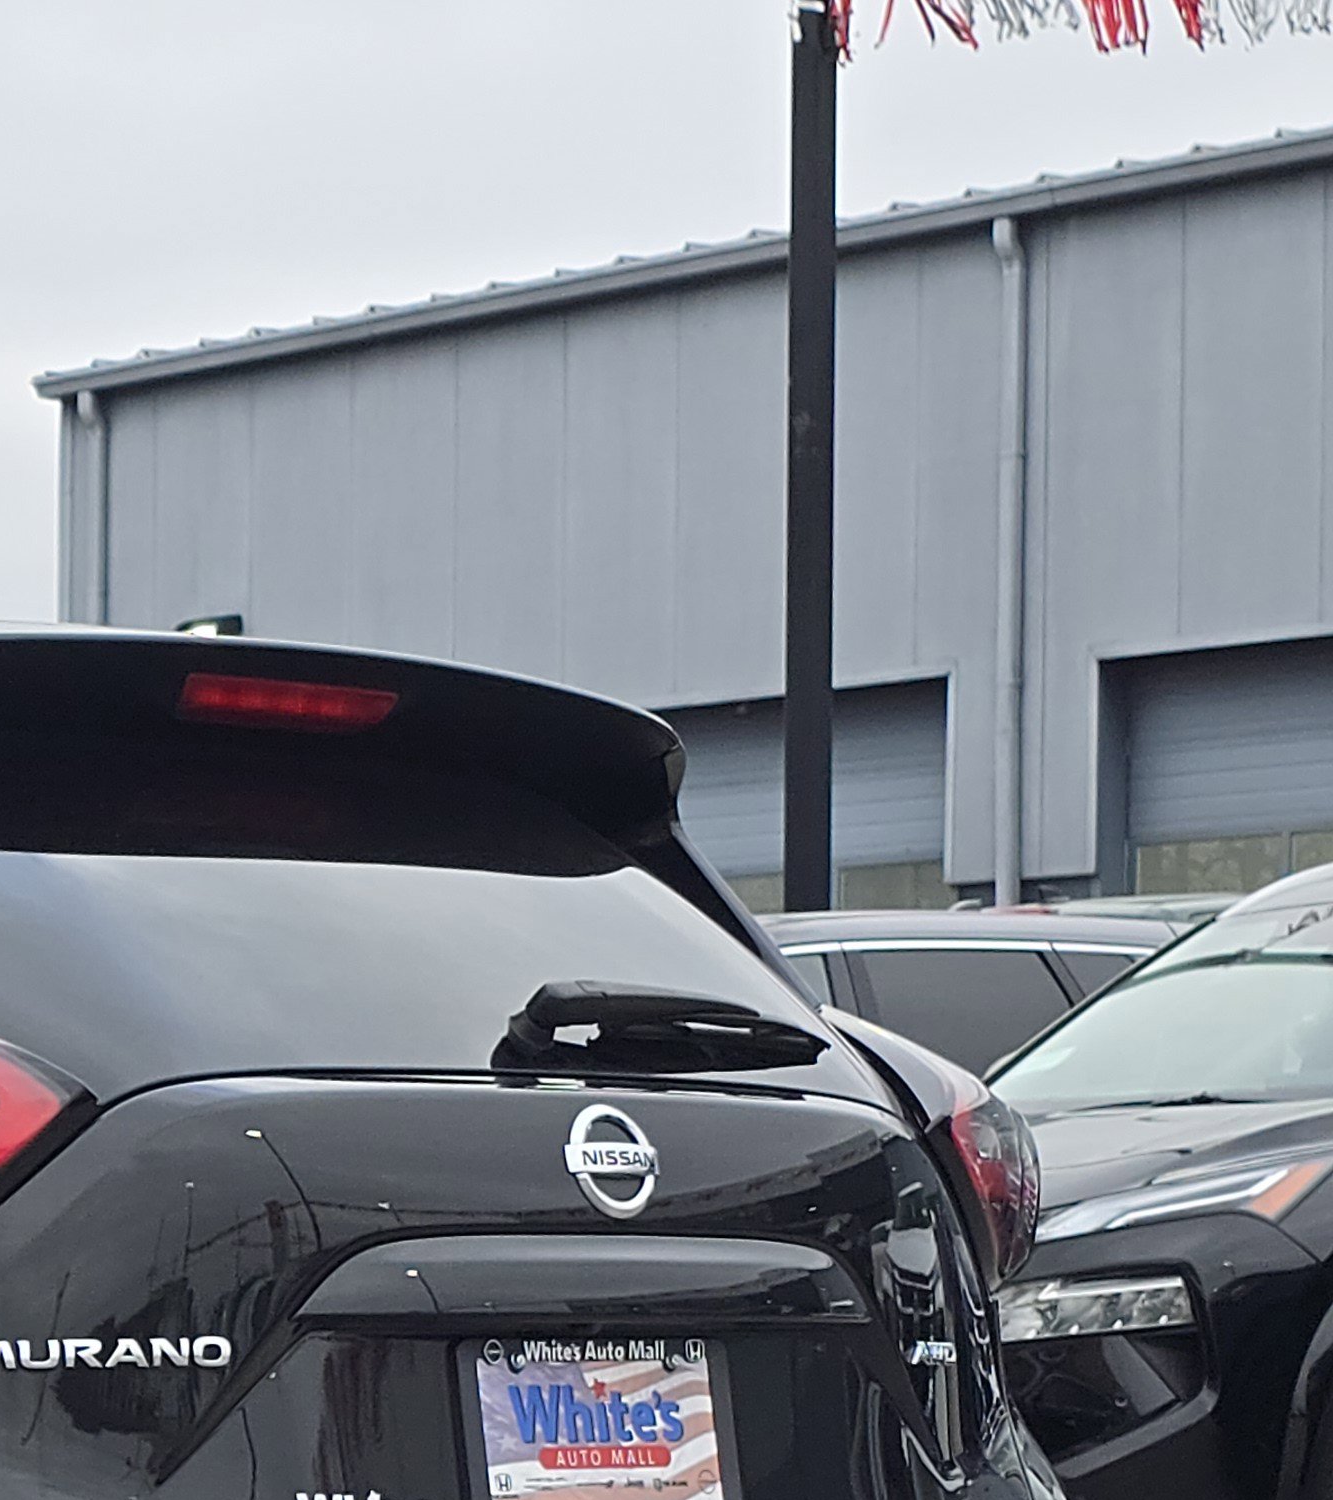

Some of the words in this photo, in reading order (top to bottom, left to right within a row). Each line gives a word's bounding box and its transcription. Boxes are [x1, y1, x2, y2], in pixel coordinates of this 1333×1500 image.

[582, 1149, 655, 1168] NISSAN
[522, 1338, 582, 1363] White's
[584, 1340, 625, 1361] Auto
[627, 1339, 665, 1361] Mall
[507, 1379, 685, 1444] White's
[555, 1450, 602, 1468] AUTO
[610, 1449, 656, 1466] MALL
